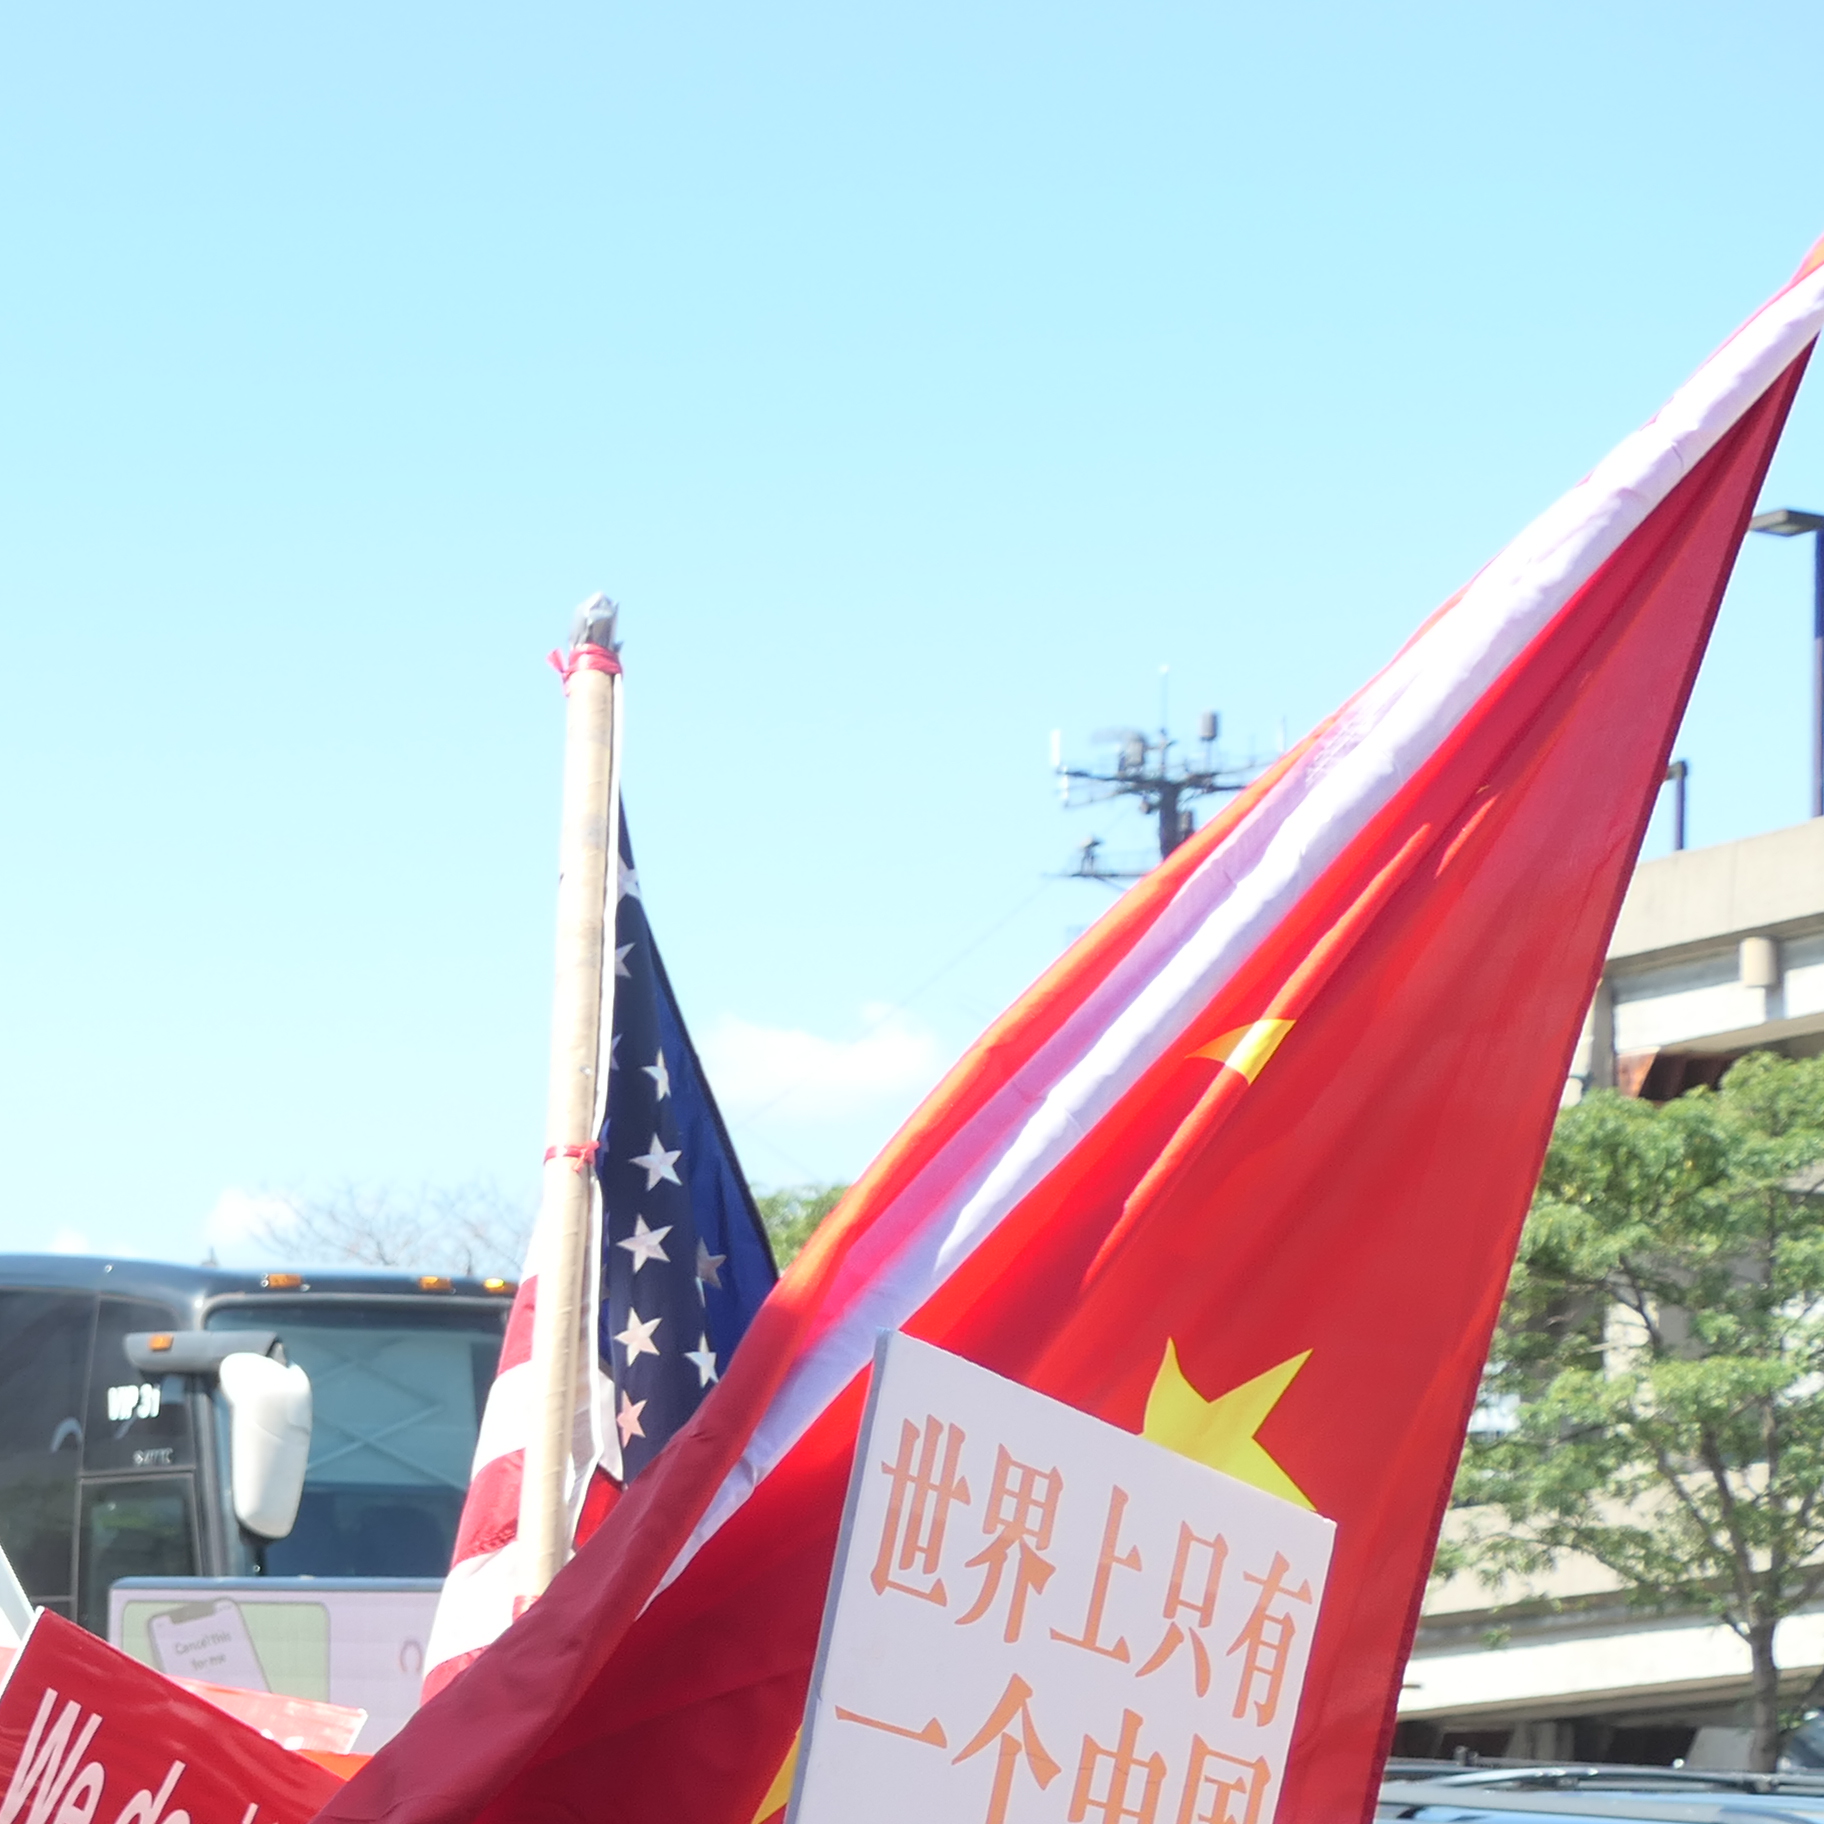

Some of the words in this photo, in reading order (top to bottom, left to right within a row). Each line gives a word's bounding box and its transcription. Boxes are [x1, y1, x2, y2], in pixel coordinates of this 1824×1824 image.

[870, 1413, 1315, 1728] 世界上只有
